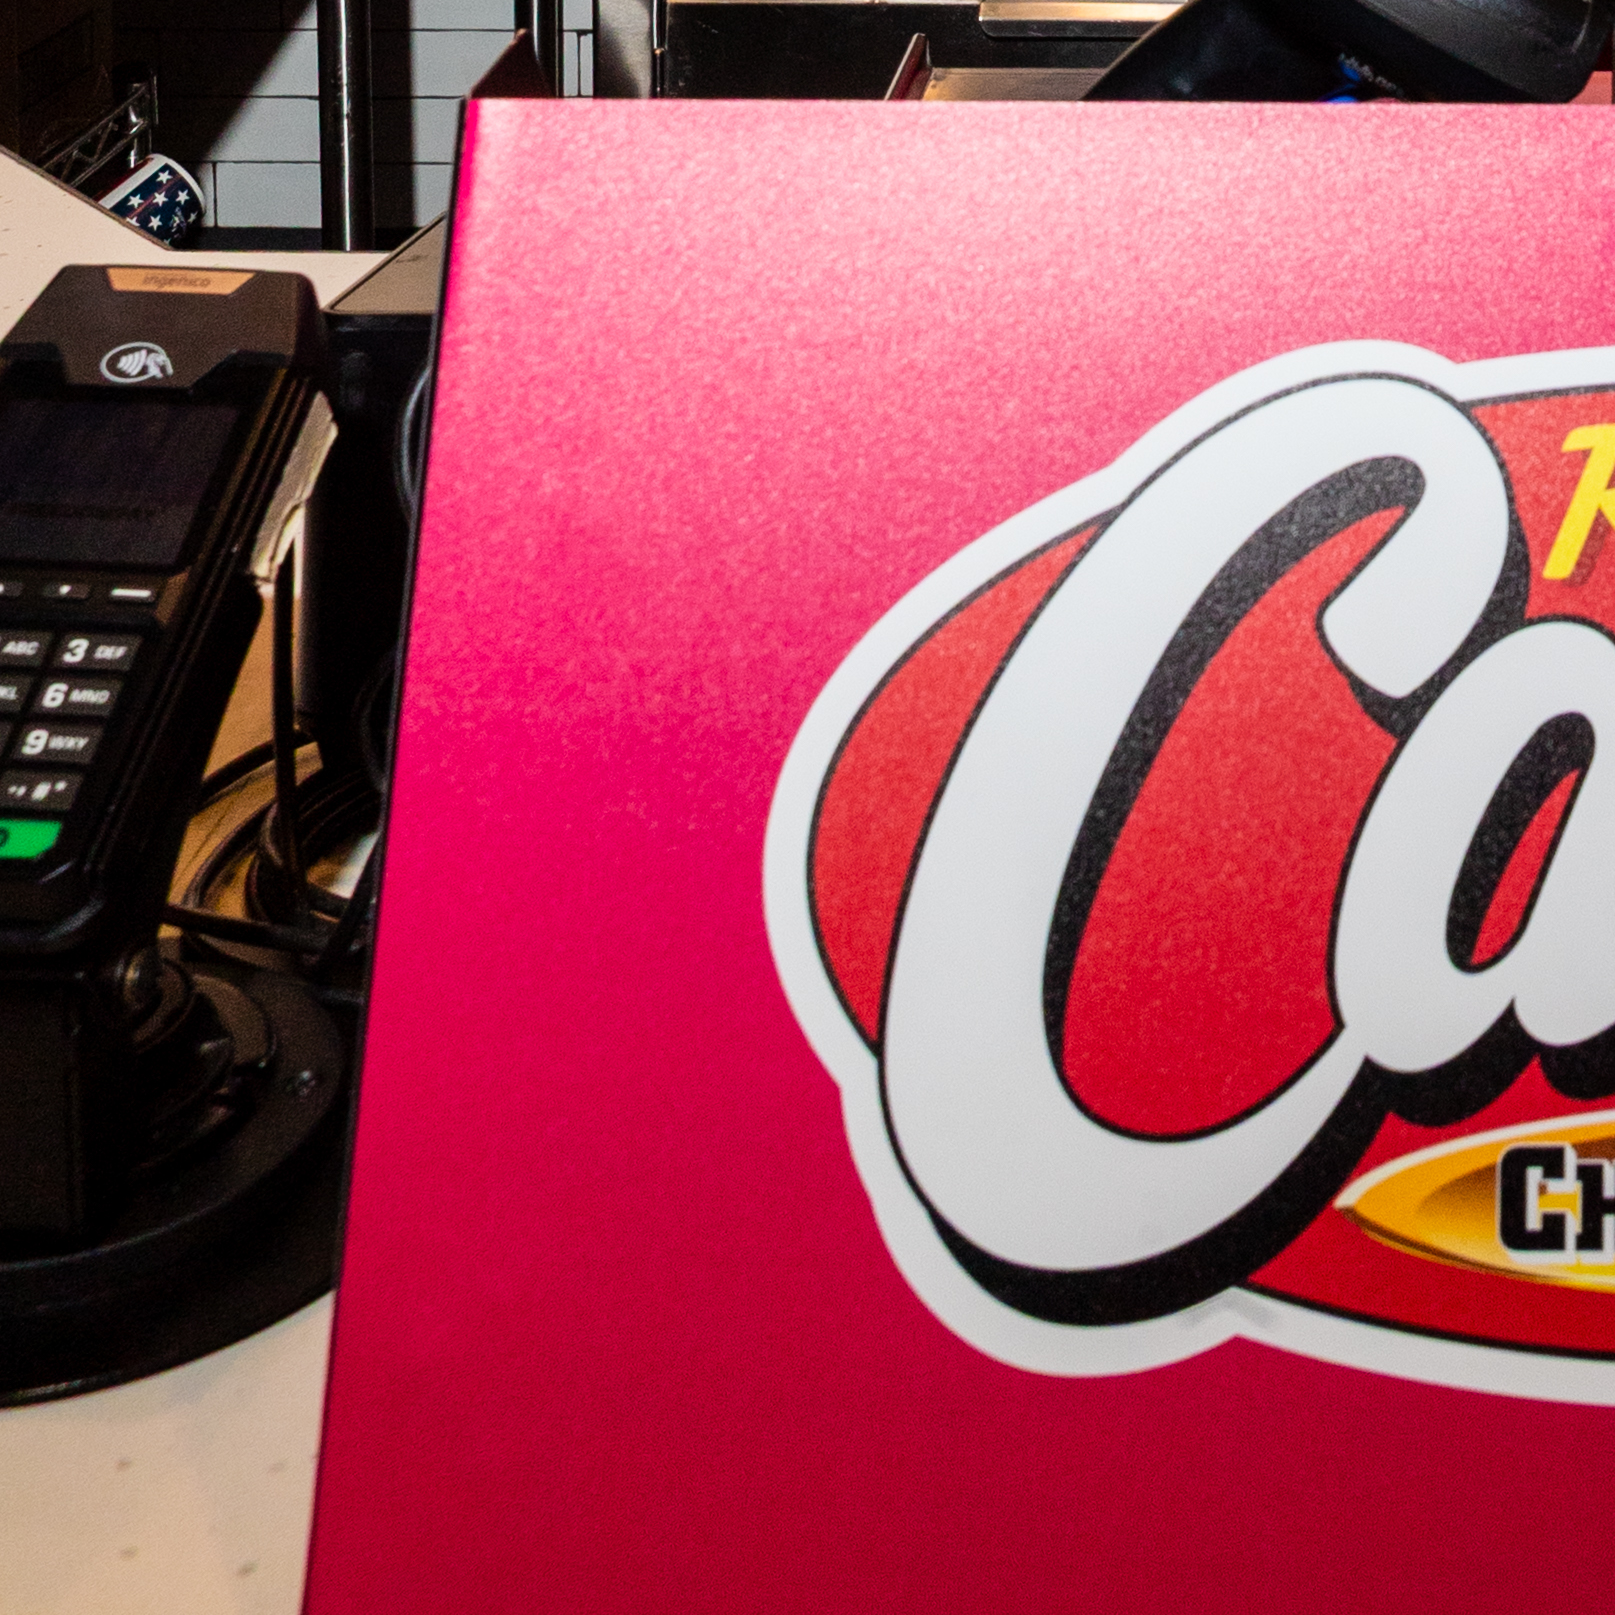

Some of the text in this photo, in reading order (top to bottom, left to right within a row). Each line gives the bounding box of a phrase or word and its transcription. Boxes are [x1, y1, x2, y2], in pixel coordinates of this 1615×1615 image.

[62, 637, 128, 664] 3 DEF
[41, 682, 111, 708] 6 MNO
[21, 728, 49, 756] 9
